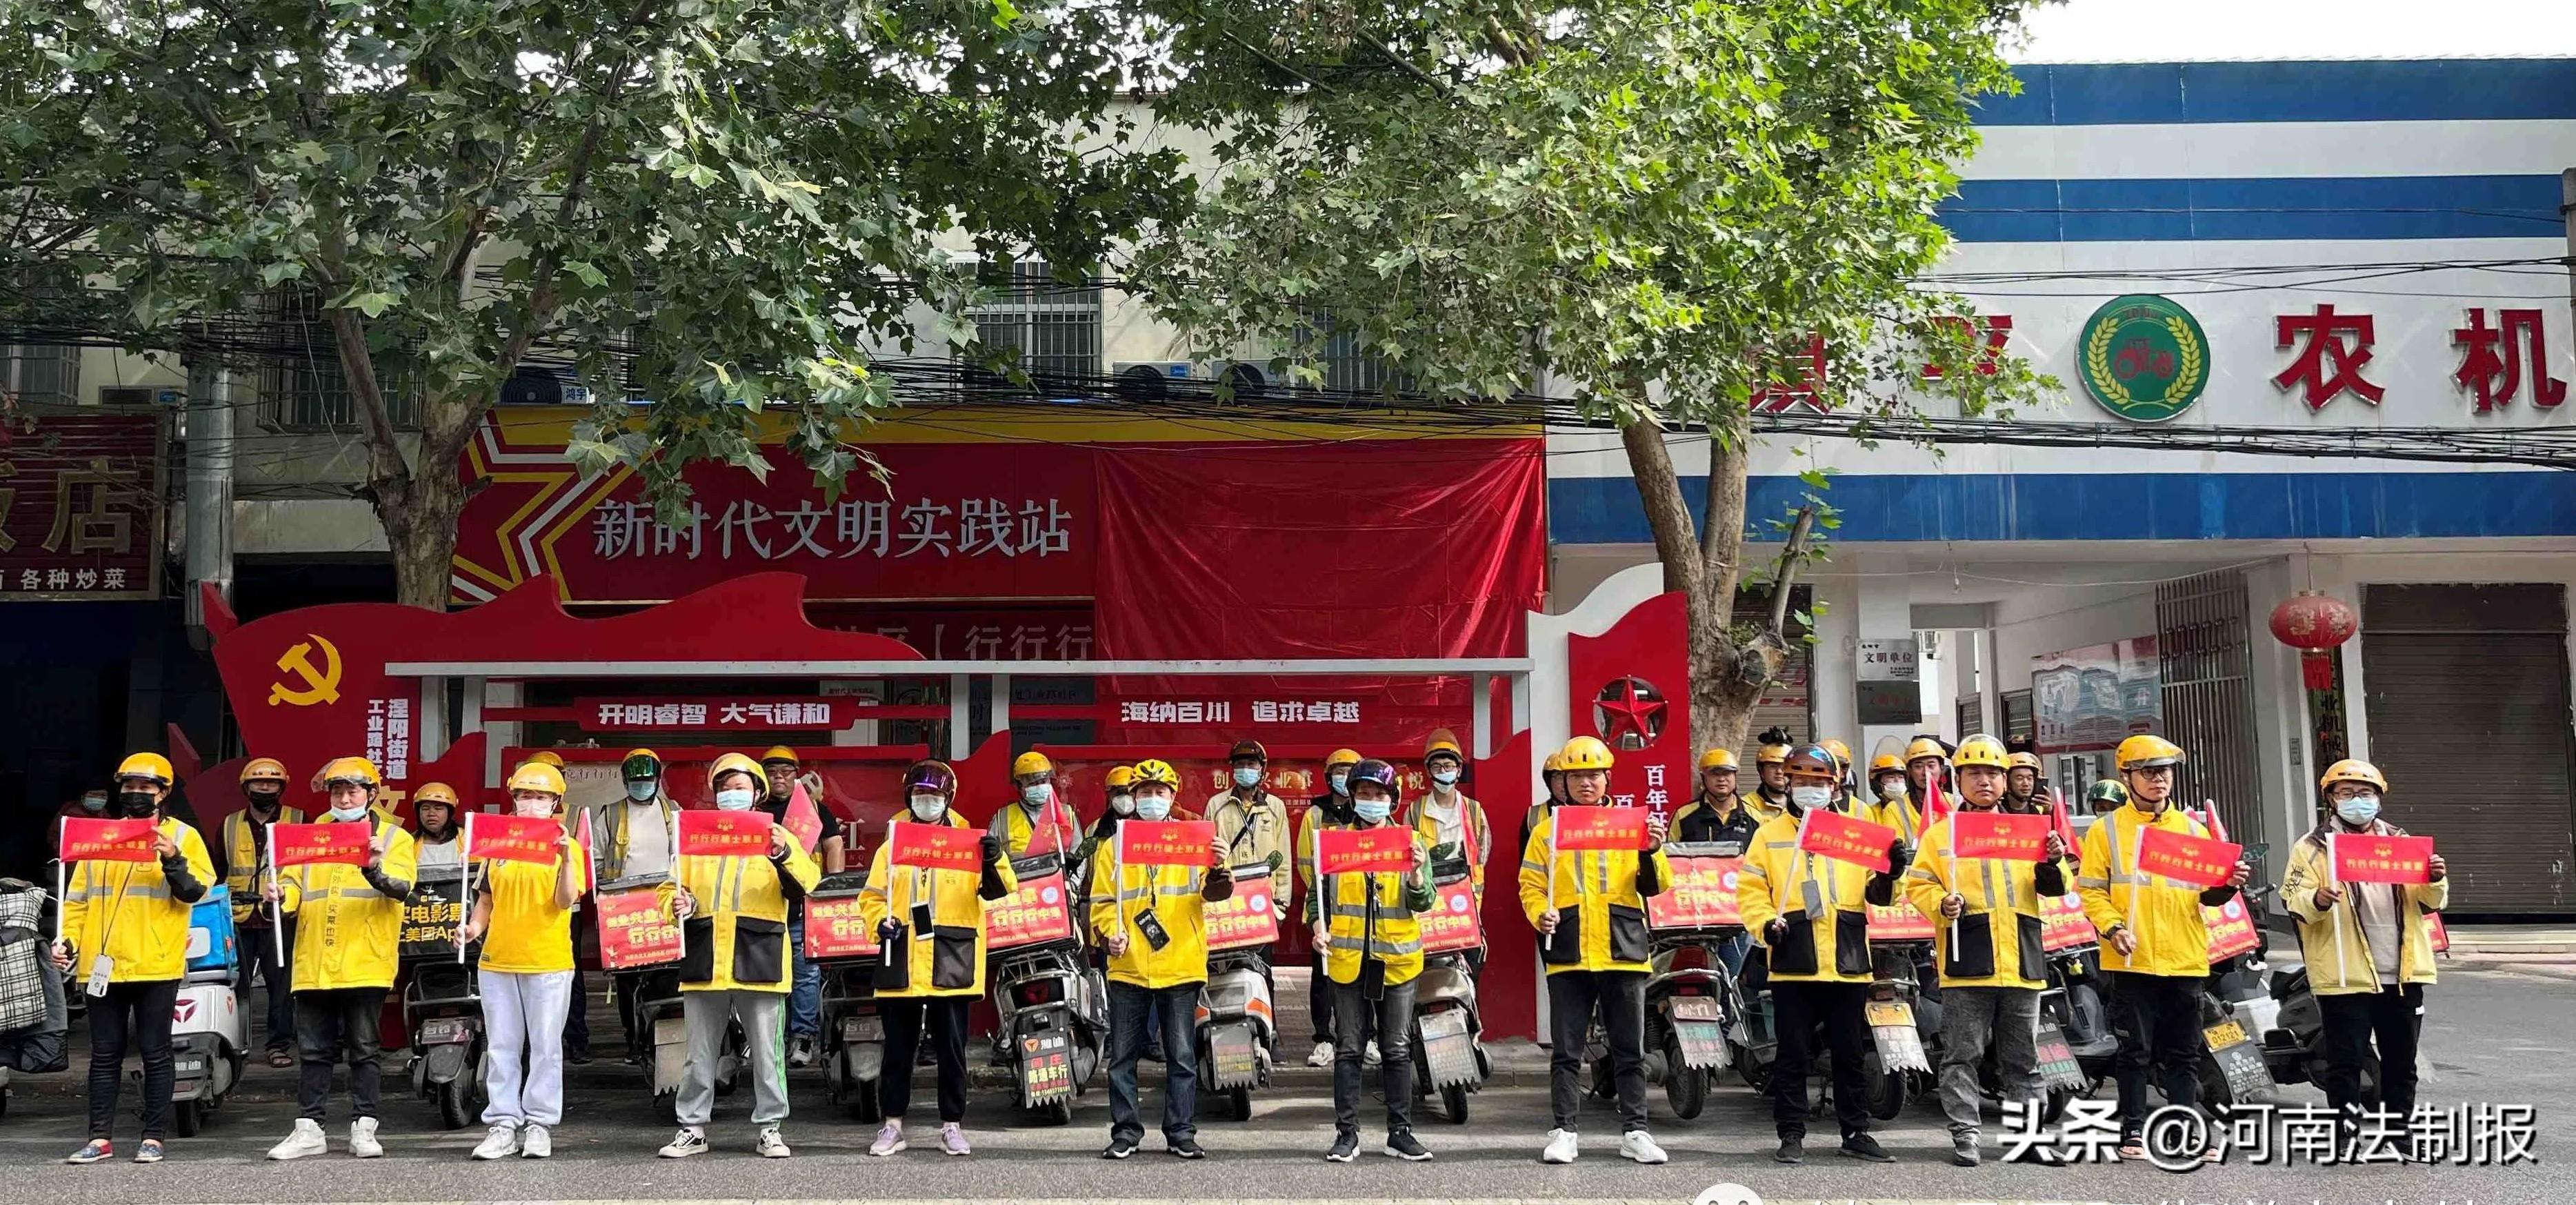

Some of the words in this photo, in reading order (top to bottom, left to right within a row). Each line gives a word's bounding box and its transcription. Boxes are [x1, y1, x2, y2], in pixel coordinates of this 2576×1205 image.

[2270, 303, 2567, 415] 农机
[0, 455, 139, 554] 店
[592, 498, 1072, 559] 新时代文明实践站
[20, 568, 126, 590] 各种炒菜
[1864, 652, 1913, 663] 文明单位
[598, 704, 707, 726] 开明睿智
[720, 703, 830, 725] 大气谦和
[1121, 701, 1230, 723] 海纳百川
[1252, 700, 1360, 723] 追求卓越
